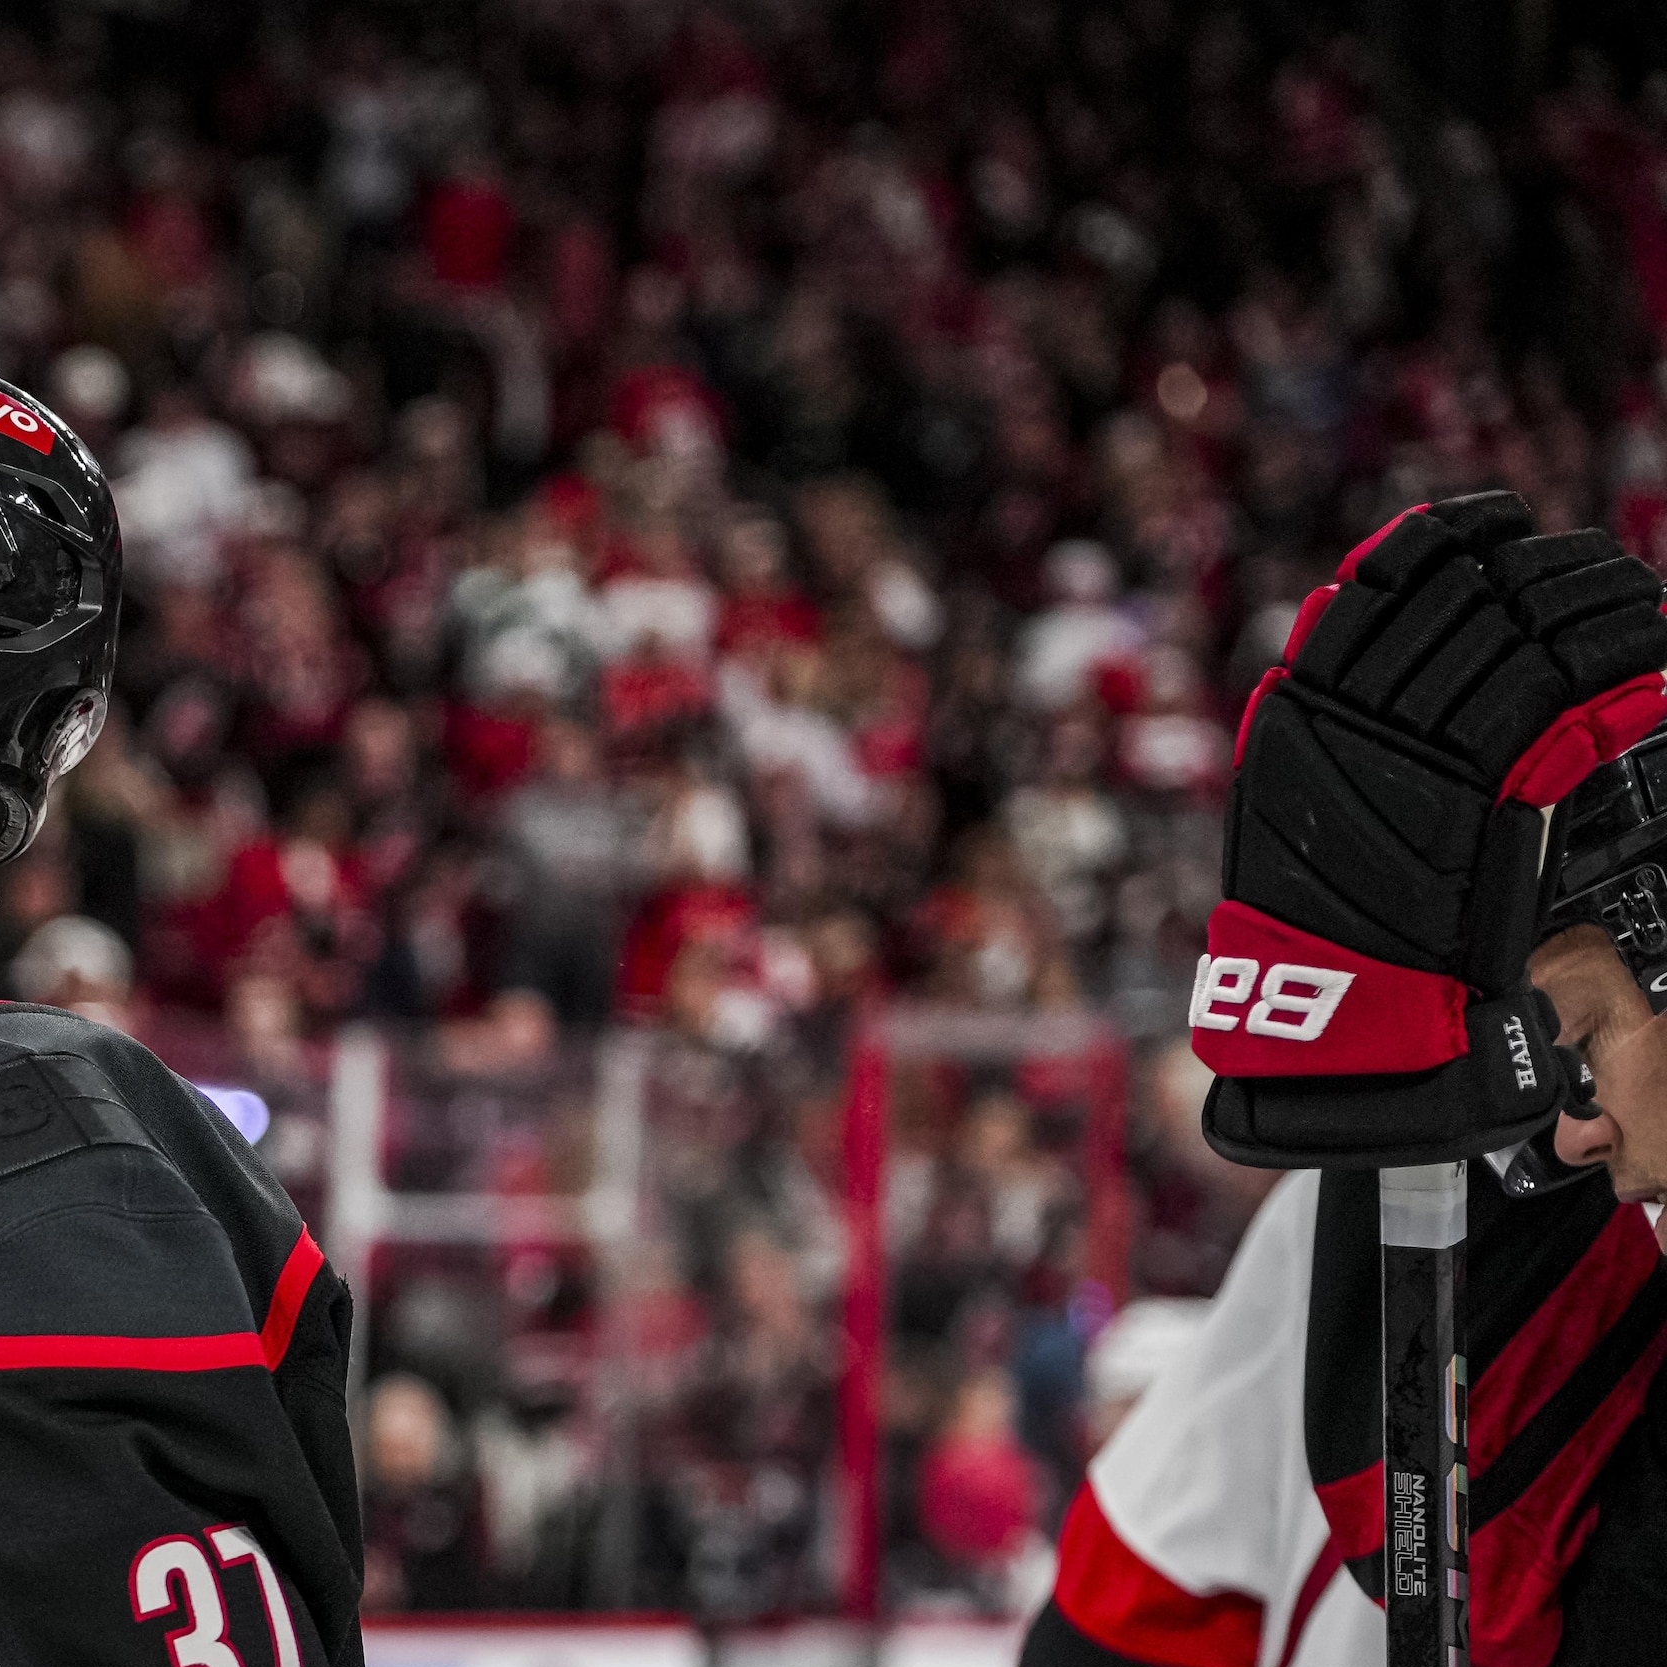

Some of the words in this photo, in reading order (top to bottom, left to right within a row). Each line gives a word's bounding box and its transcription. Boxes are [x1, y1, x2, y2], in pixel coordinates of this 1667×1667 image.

[1502, 1015, 1538, 1090] HALL
[1393, 1471, 1414, 1597] SHIELD
[1412, 1474, 1427, 1597] NANOLITE
